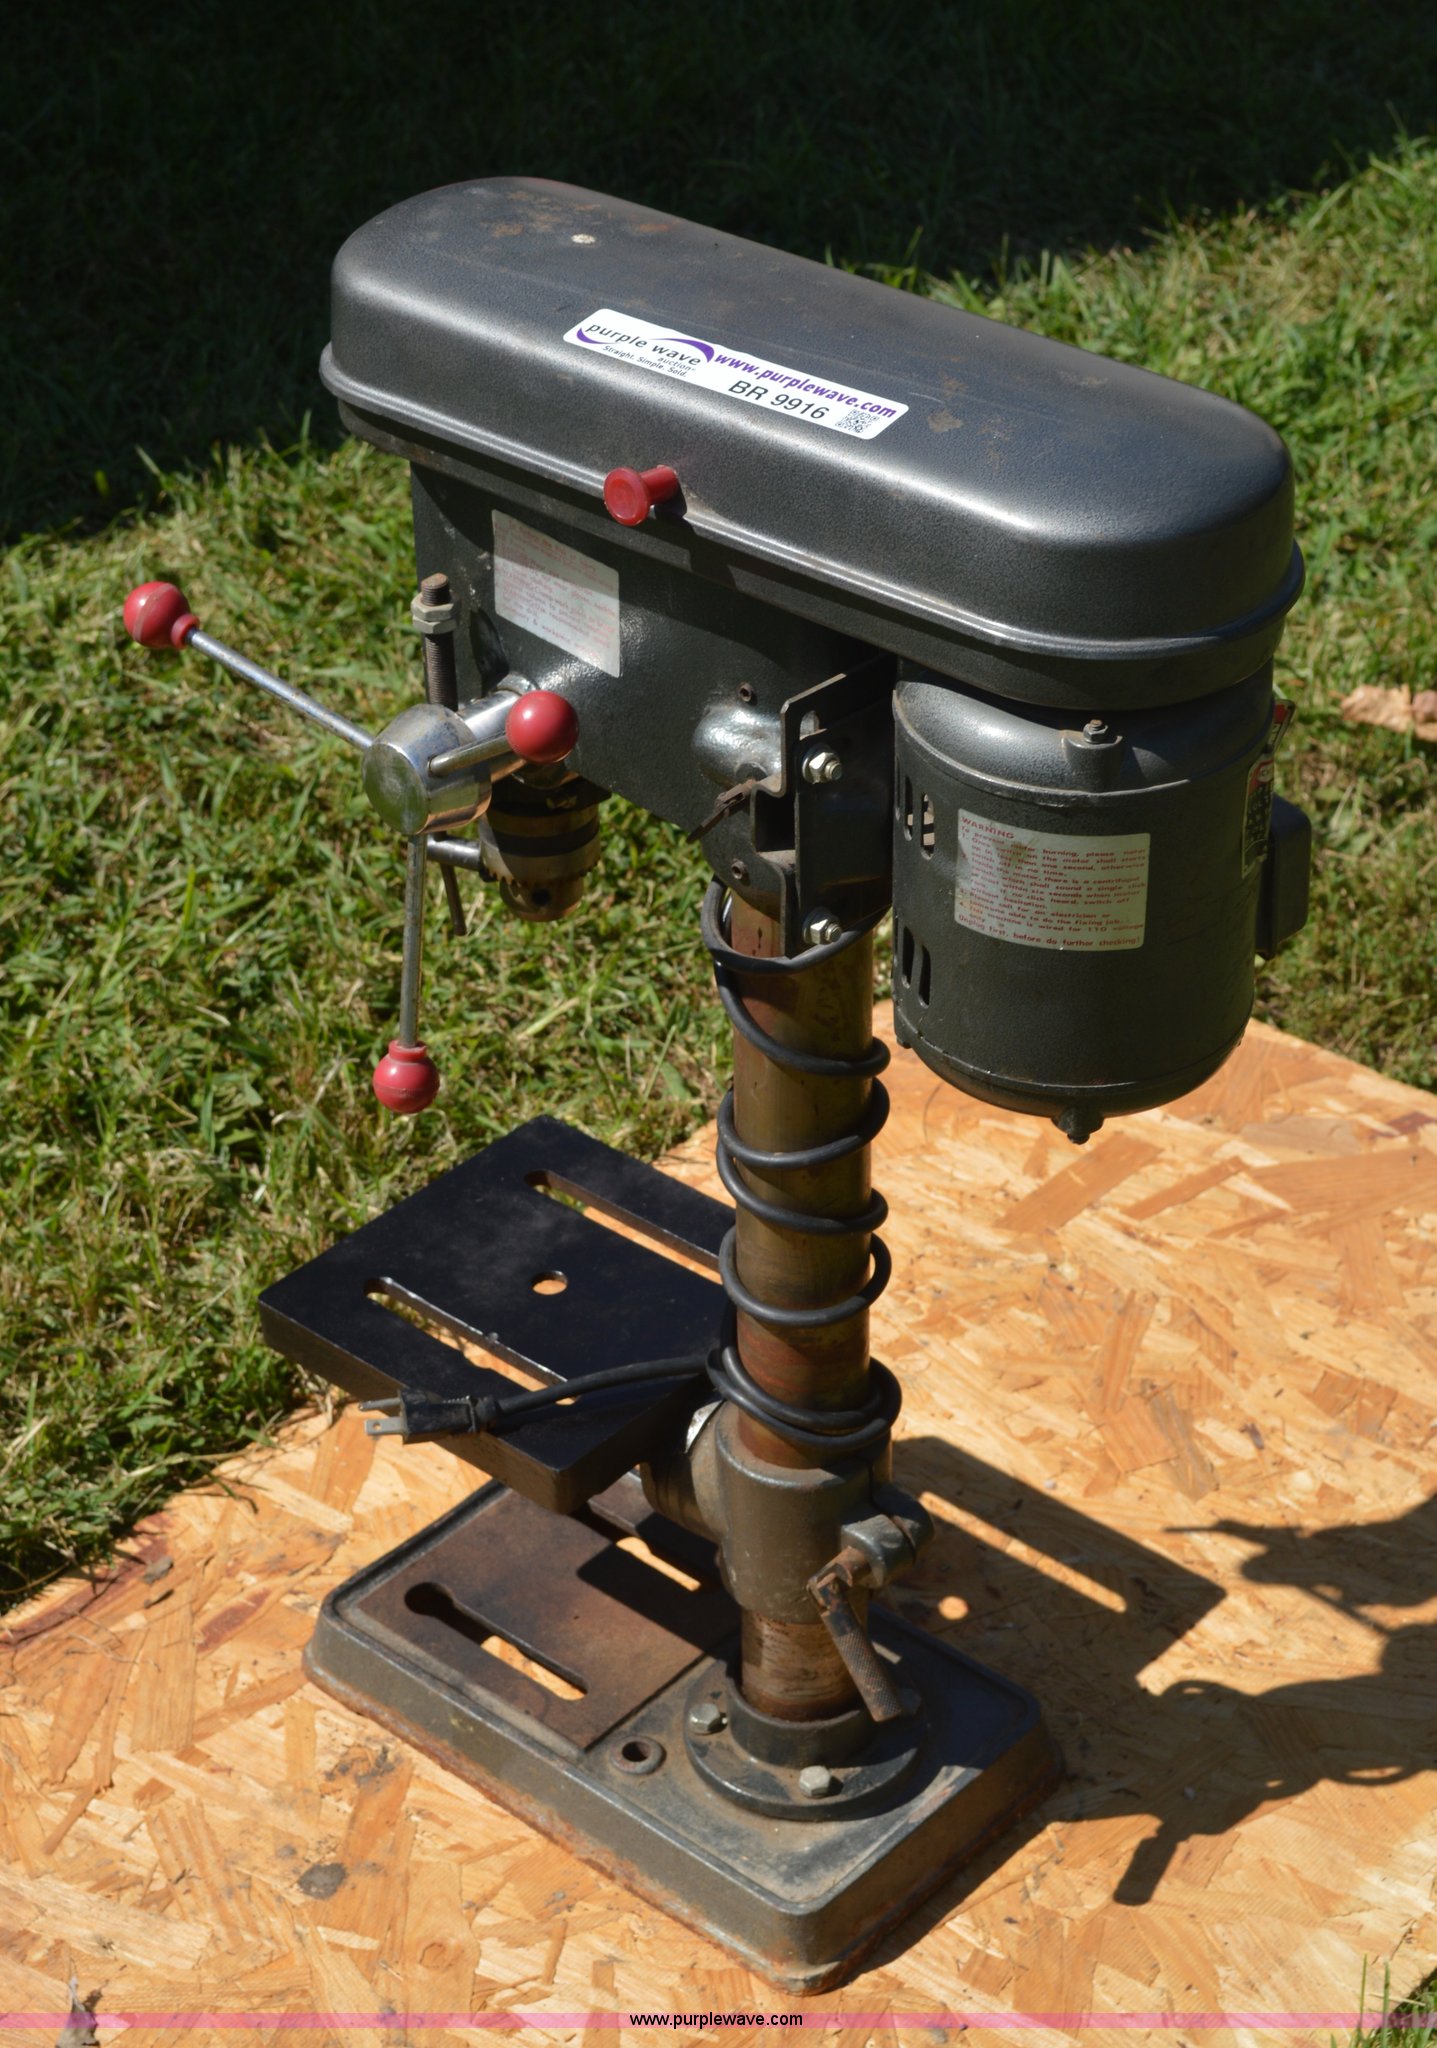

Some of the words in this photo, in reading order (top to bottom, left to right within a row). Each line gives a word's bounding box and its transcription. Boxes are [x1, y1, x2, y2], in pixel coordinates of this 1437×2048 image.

[588, 323, 647, 347] purple
[653, 345, 701, 366] wave
[602, 345, 635, 361] Straight.
[637, 356, 665, 371] Simple.
[667, 366, 687, 378] Sold.
[714, 354, 897, 419] www.purplewave.com
[728, 380, 768, 401] BR
[770, 394, 830, 420] 9916
[961, 817, 1015, 839] WARNING
[1013, 932, 1041, 942] before
